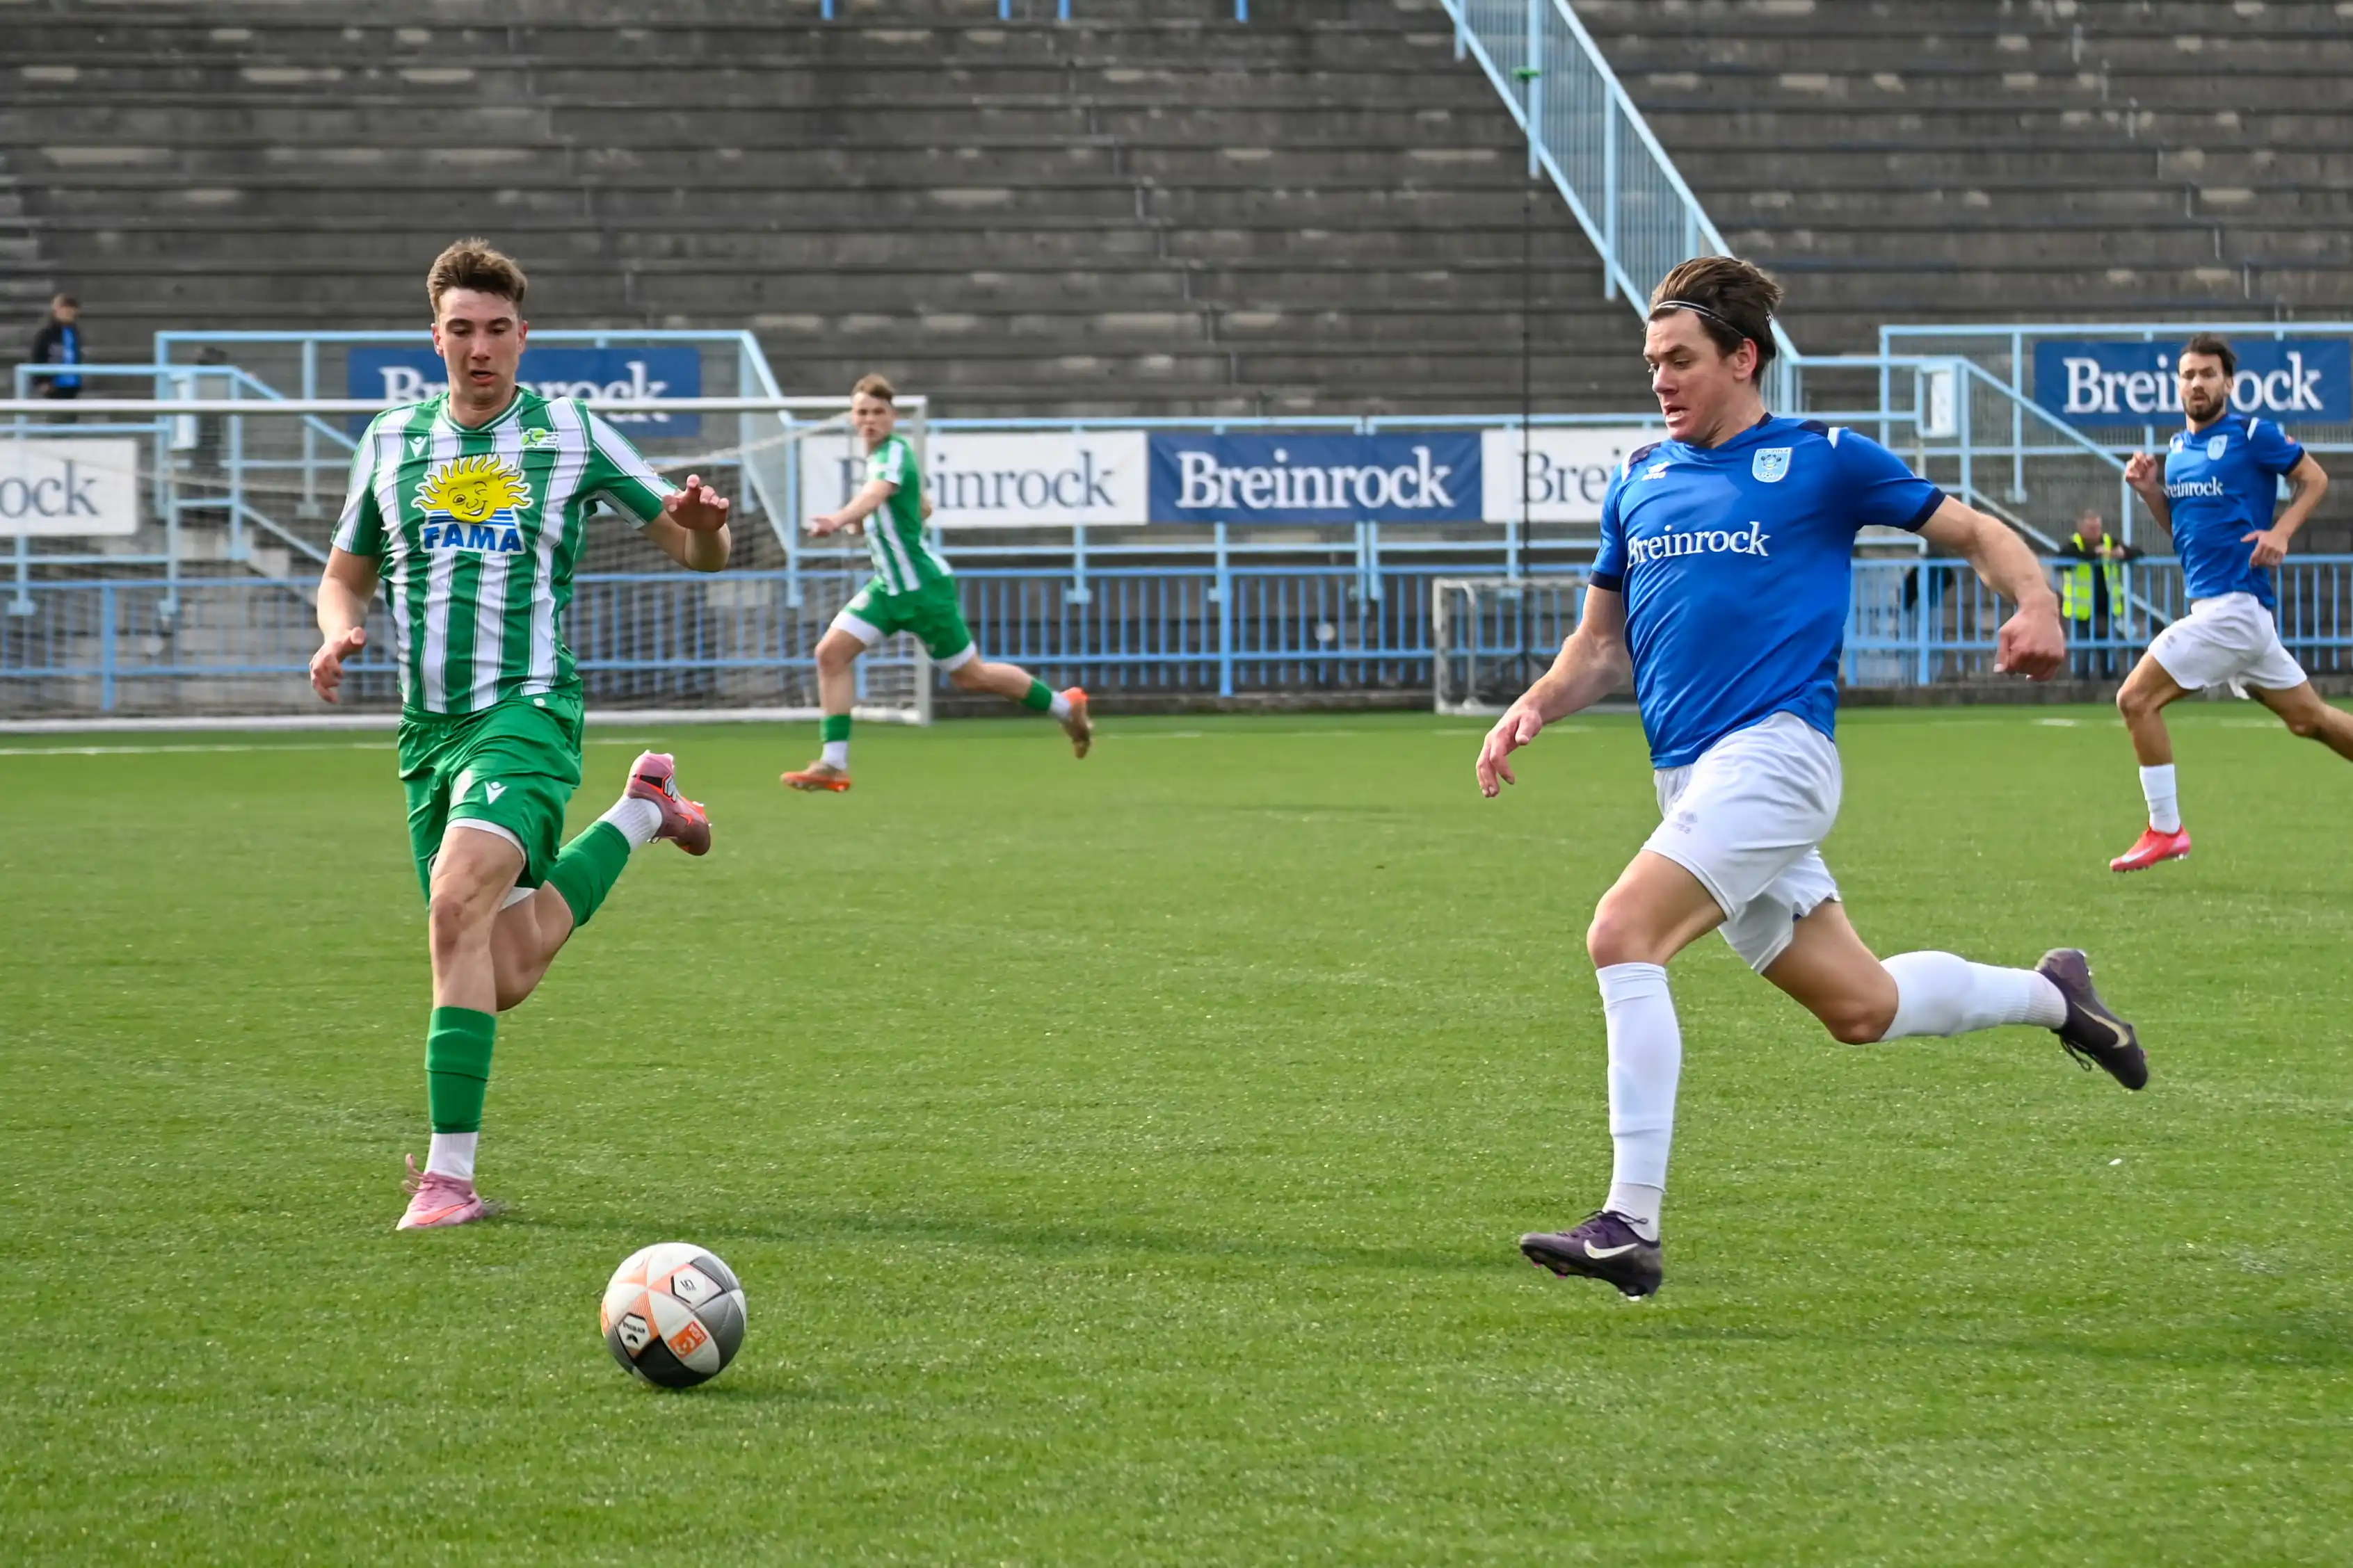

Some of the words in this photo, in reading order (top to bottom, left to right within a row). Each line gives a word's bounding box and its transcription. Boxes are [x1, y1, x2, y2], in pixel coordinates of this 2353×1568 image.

[2063, 351, 2324, 414] Breiock
[835, 450, 1116, 509] Binrock
[1175, 445, 1454, 508] Breinrock
[1517, 447, 1621, 504] Bre
[423, 523, 522, 553] FAMA
